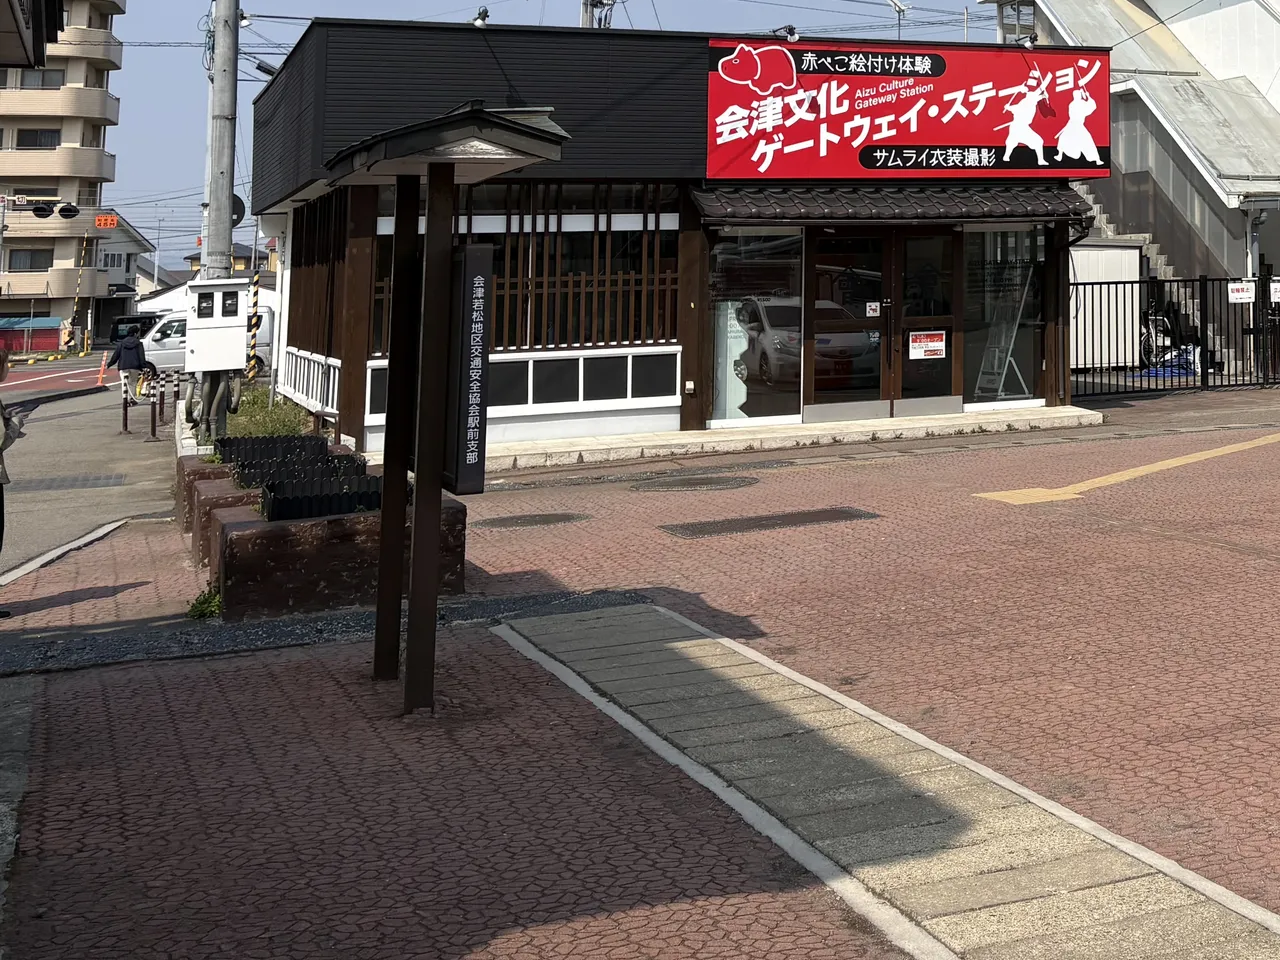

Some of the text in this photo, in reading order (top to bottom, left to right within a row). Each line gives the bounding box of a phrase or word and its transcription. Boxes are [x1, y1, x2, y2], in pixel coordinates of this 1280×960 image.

[801, 52, 932, 75] 赤べこ絵付け体験
[854, 78, 914, 99] Aizu Culture
[854, 83, 934, 110] Gateway Station
[714, 81, 850, 146] 会津文化
[750, 58, 1102, 174] ゲートウェイ・ステーション
[872, 147, 996, 168] サムライ衣装撮影
[465, 275, 485, 465] 会津若松地区交通安全協会駅前支部
